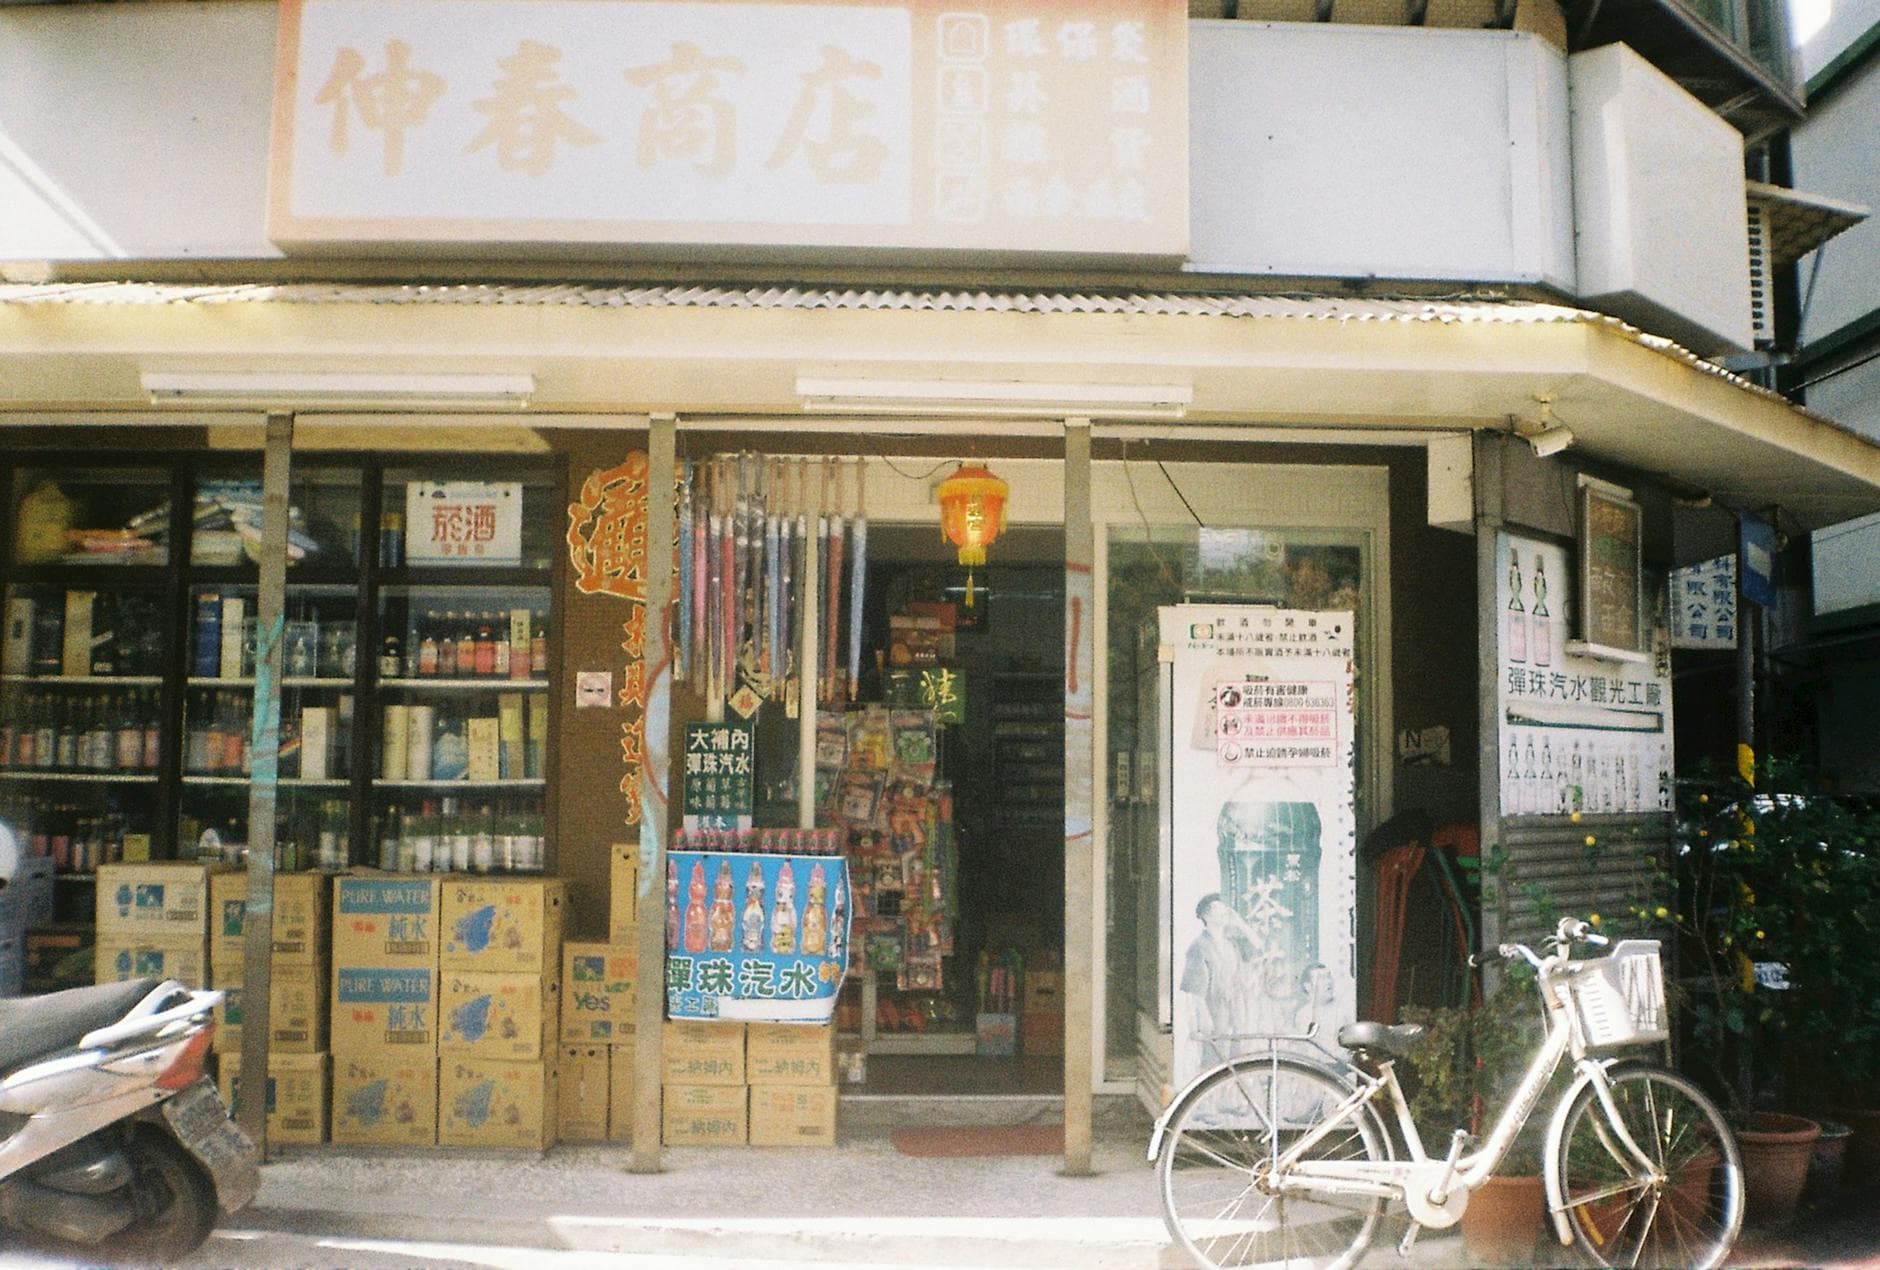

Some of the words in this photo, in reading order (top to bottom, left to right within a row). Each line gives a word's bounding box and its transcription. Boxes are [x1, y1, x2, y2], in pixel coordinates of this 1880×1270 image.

[314, 38, 890, 185] 伸春商店
[431, 504, 497, 542] 菸酒
[1508, 666, 1662, 707] 彈珠汽水觀光工廠
[687, 752, 750, 775] 彈珠汽水
